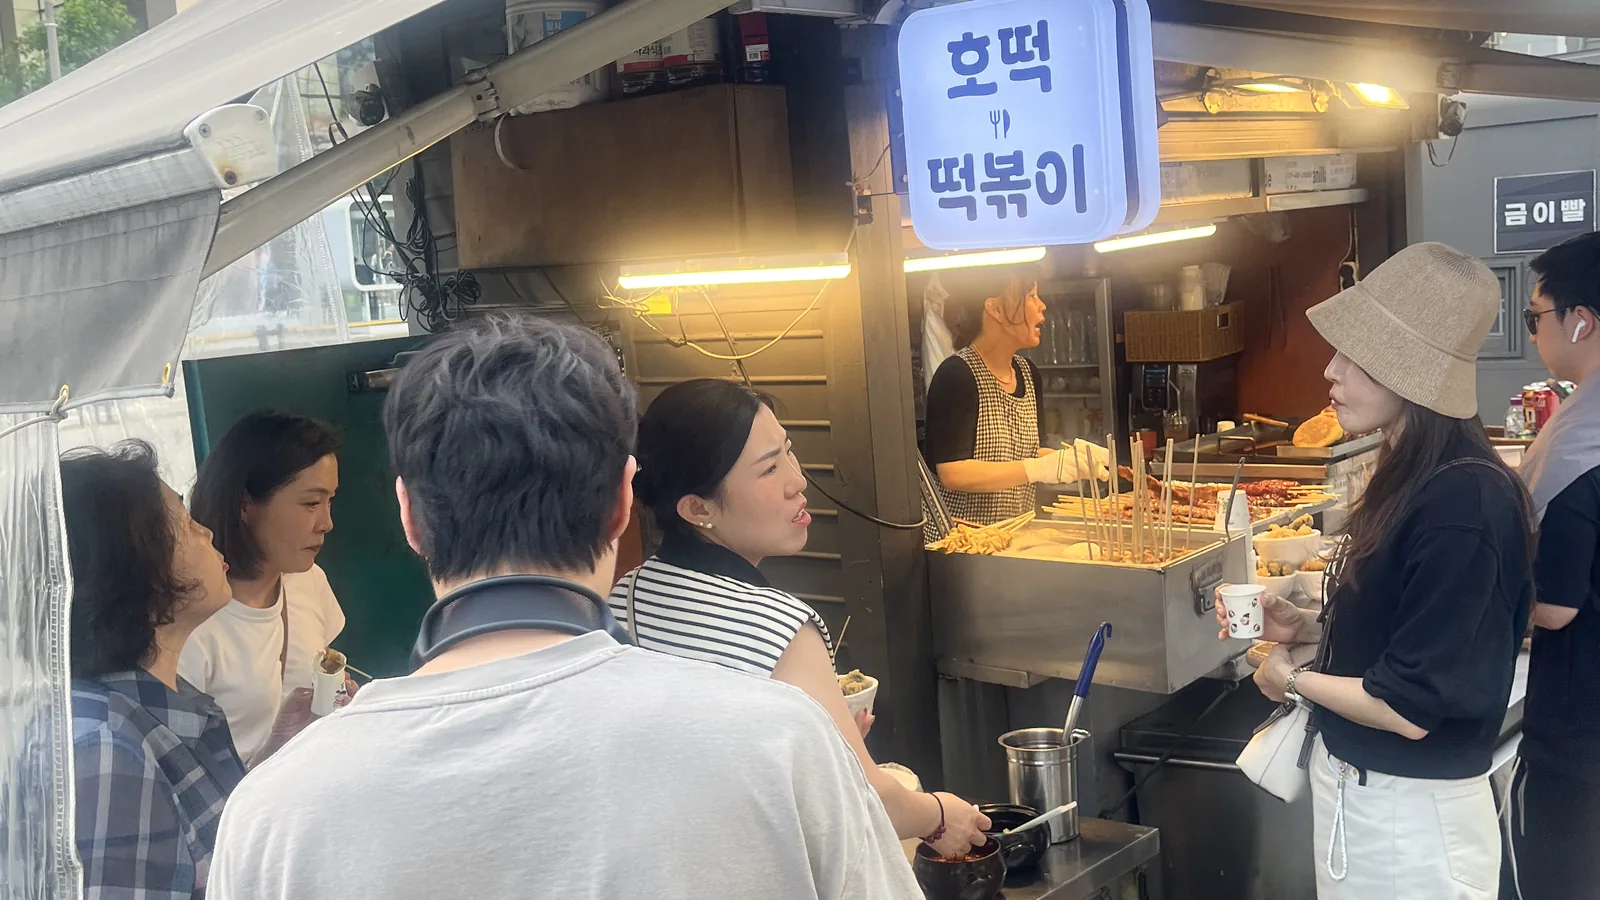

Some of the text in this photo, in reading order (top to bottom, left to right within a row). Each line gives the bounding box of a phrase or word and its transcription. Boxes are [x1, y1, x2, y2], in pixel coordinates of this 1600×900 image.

[947, 19, 1052, 100] 호떡
[927, 144, 1088, 221] 떡볶이
[1504, 198, 1586, 226] 금이빨
